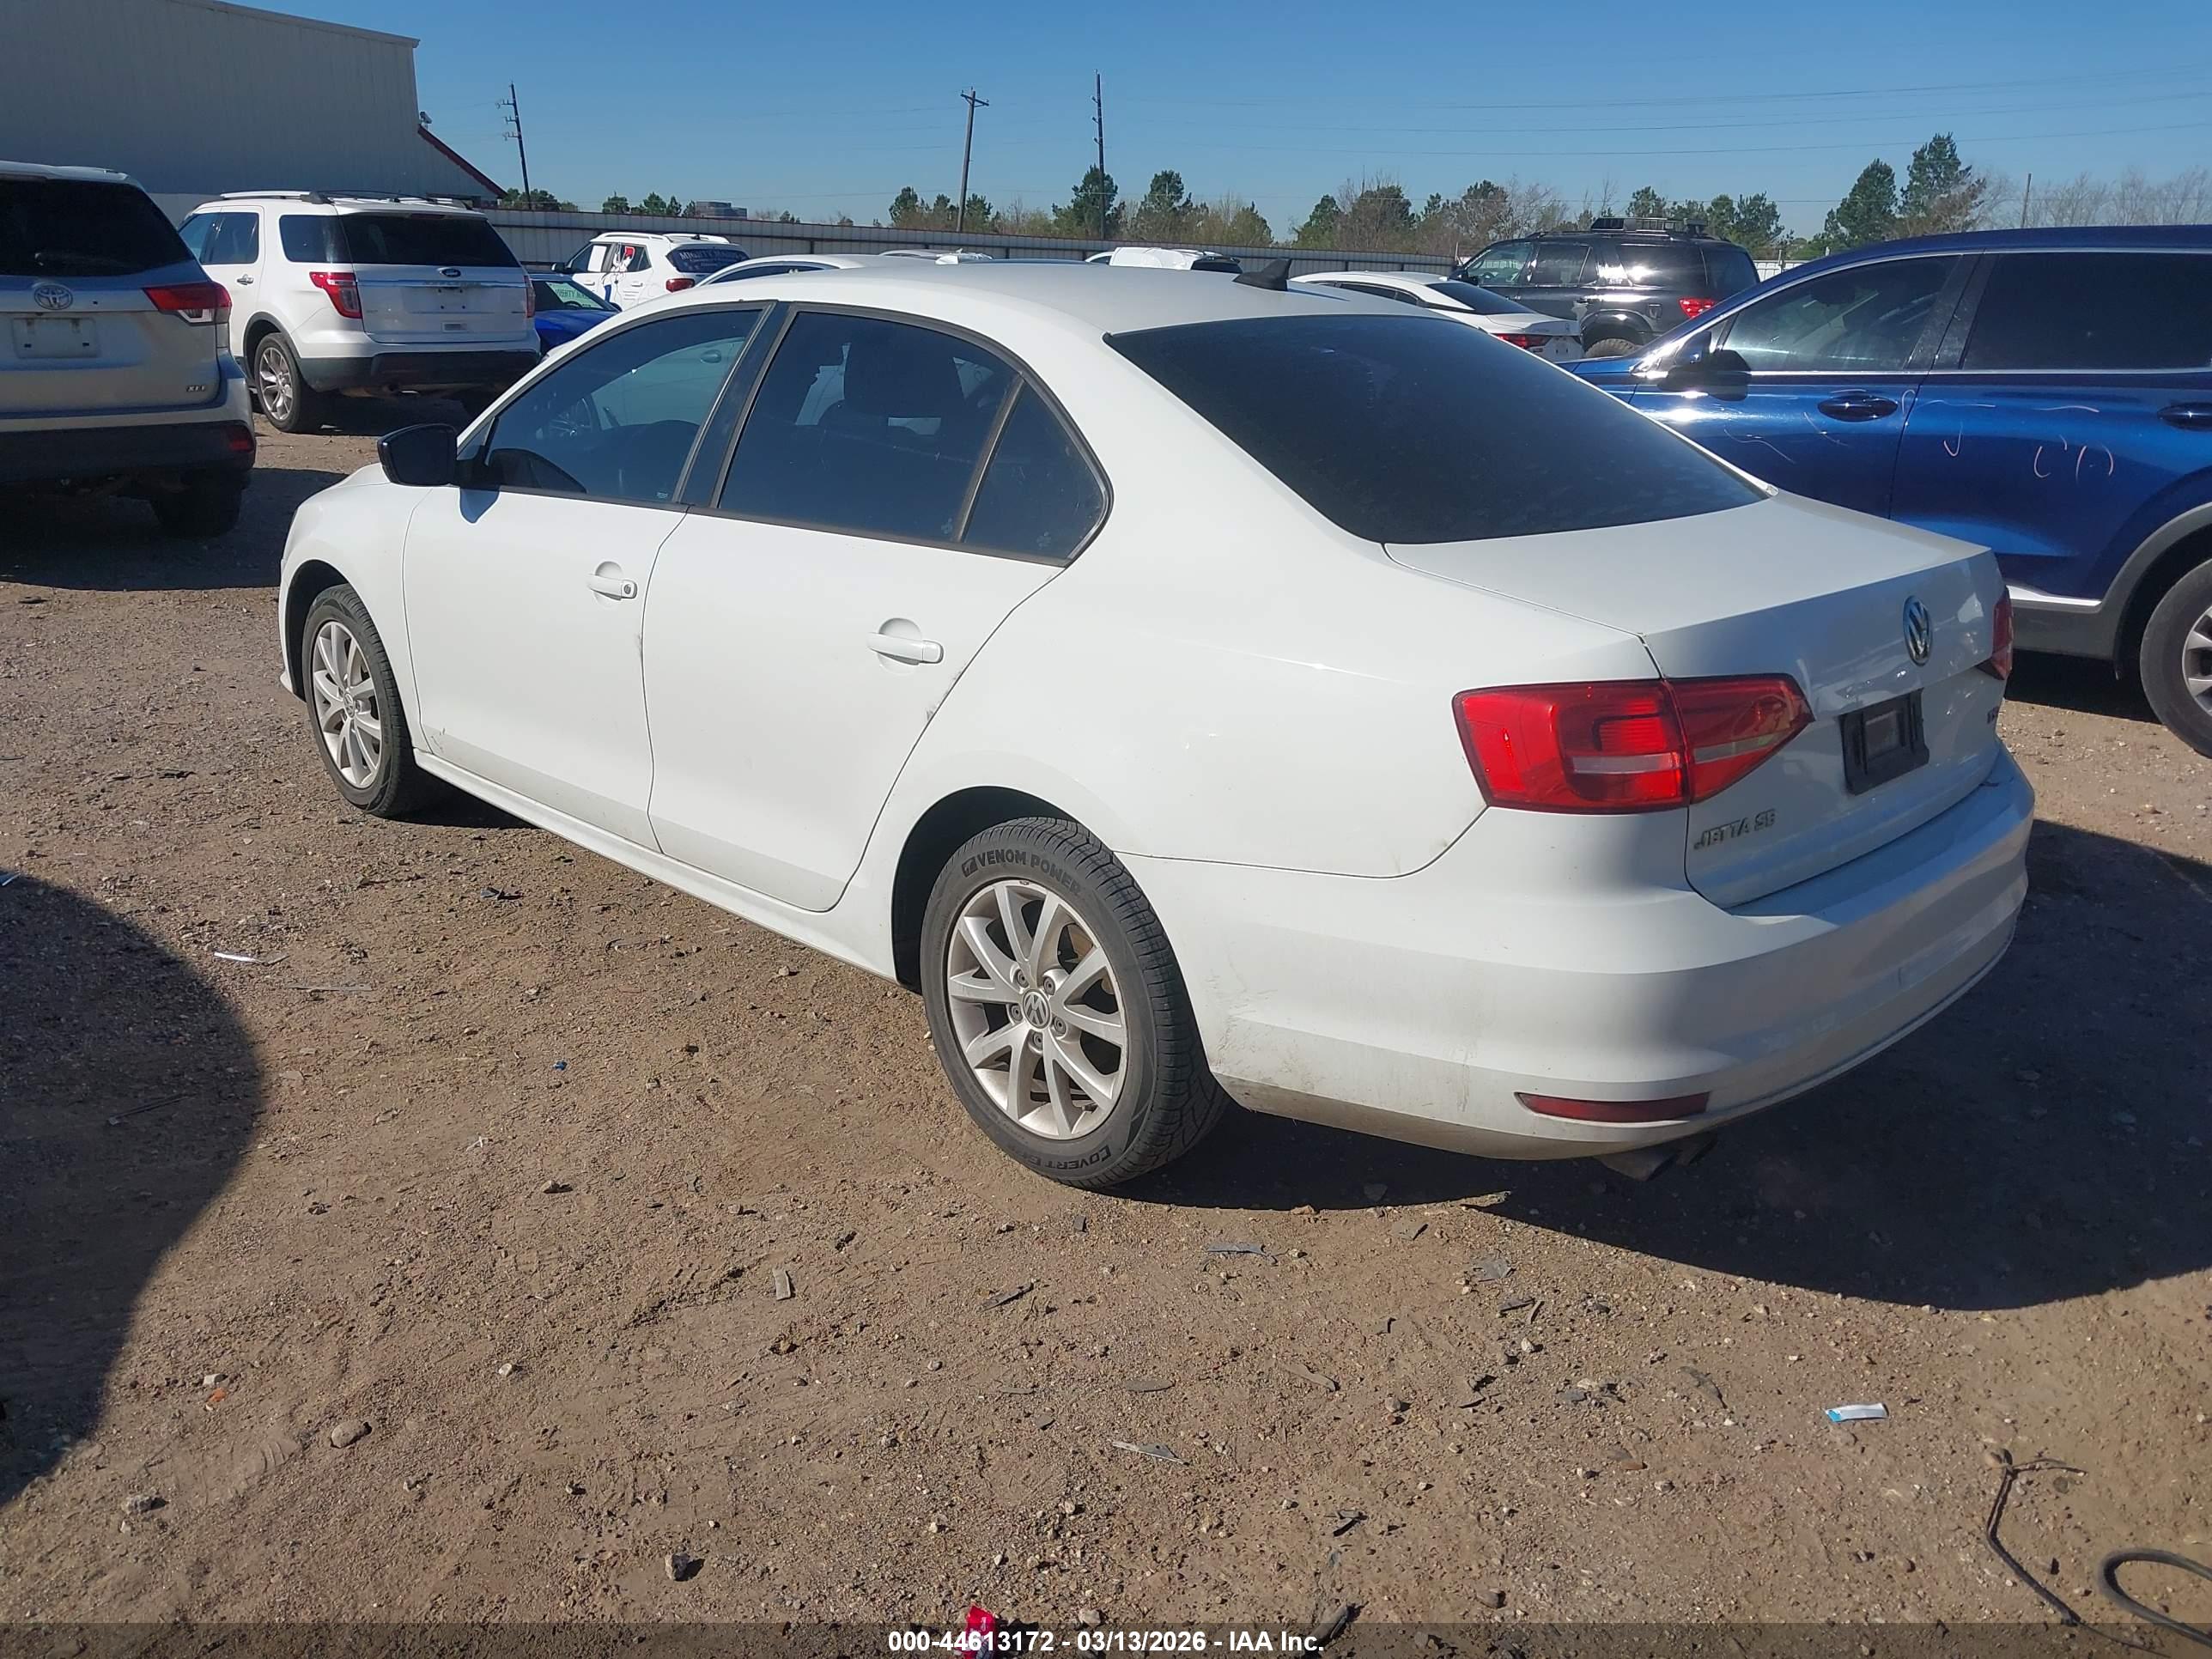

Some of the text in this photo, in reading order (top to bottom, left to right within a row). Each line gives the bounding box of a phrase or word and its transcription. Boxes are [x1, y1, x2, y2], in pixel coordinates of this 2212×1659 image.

[1694, 817, 1750, 849] JETTA
[976, 848, 1081, 896] VENOM POWER
[1045, 1145, 1112, 1170] COVERT
